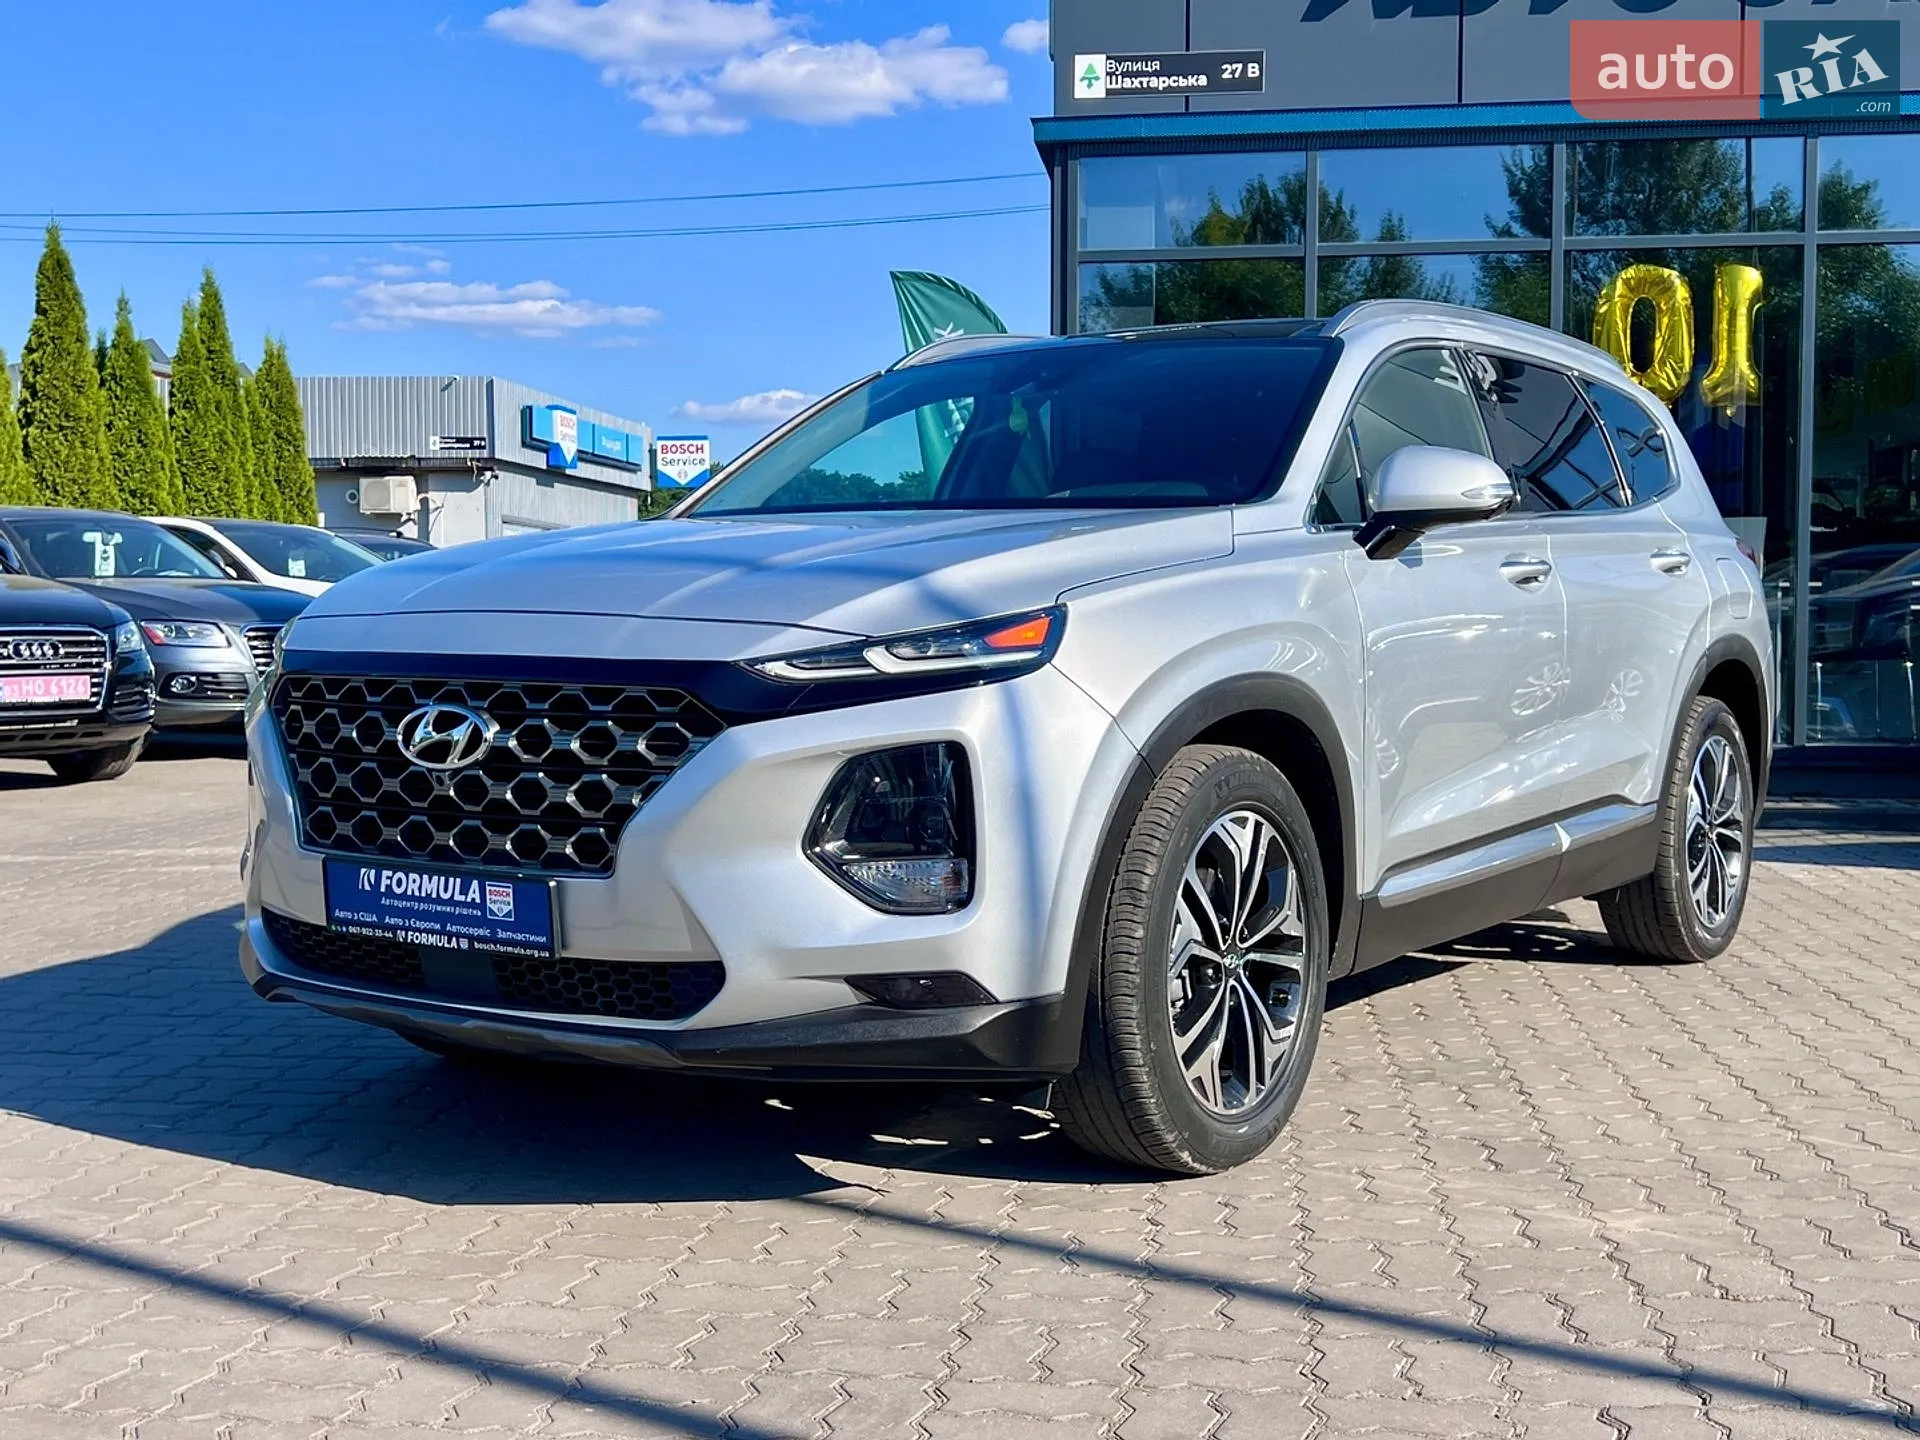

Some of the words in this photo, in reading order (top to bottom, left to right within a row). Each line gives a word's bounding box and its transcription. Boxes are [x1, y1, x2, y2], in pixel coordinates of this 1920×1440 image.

[1106, 59, 1160, 74] Вулиця
[1221, 63, 1243, 79] 27
[1106, 73, 1208, 91] Шахтарська
[660, 443, 705, 455] BOSCH
[660, 457, 706, 467] Service
[380, 870, 481, 903] FORMULA
[488, 888, 511, 898] BOSCH
[334, 908, 352, 920] Авто
[358, 911, 378, 923] США
[384, 915, 403, 926] Авто
[407, 931, 458, 949] FORMULA
[496, 928, 547, 943] Запчастини
